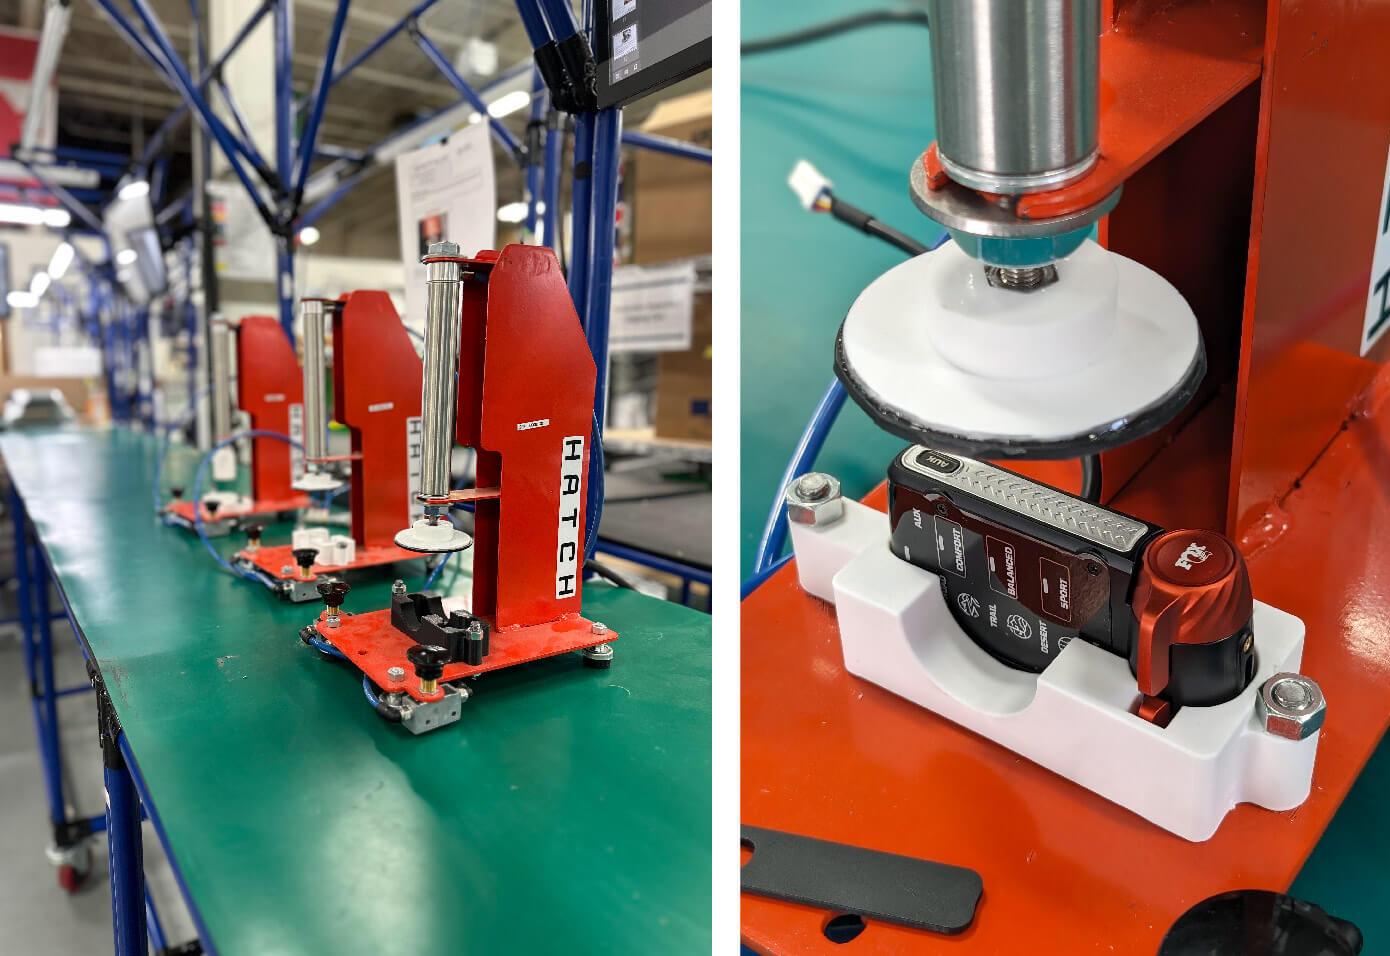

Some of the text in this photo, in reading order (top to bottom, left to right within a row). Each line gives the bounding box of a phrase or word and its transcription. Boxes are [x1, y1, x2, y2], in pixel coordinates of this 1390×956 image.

[925, 455, 951, 468] AUX
[558, 439, 582, 596] HATCH
[913, 507, 922, 529] AUX
[952, 527, 965, 572] COMFORT
[1174, 542, 1208, 571] FOX
[1004, 546, 1016, 597] BALANCED
[1059, 577, 1069, 610] SPORT
[988, 603, 997, 628] TRAIL
[1039, 619, 1049, 654] DESERT
